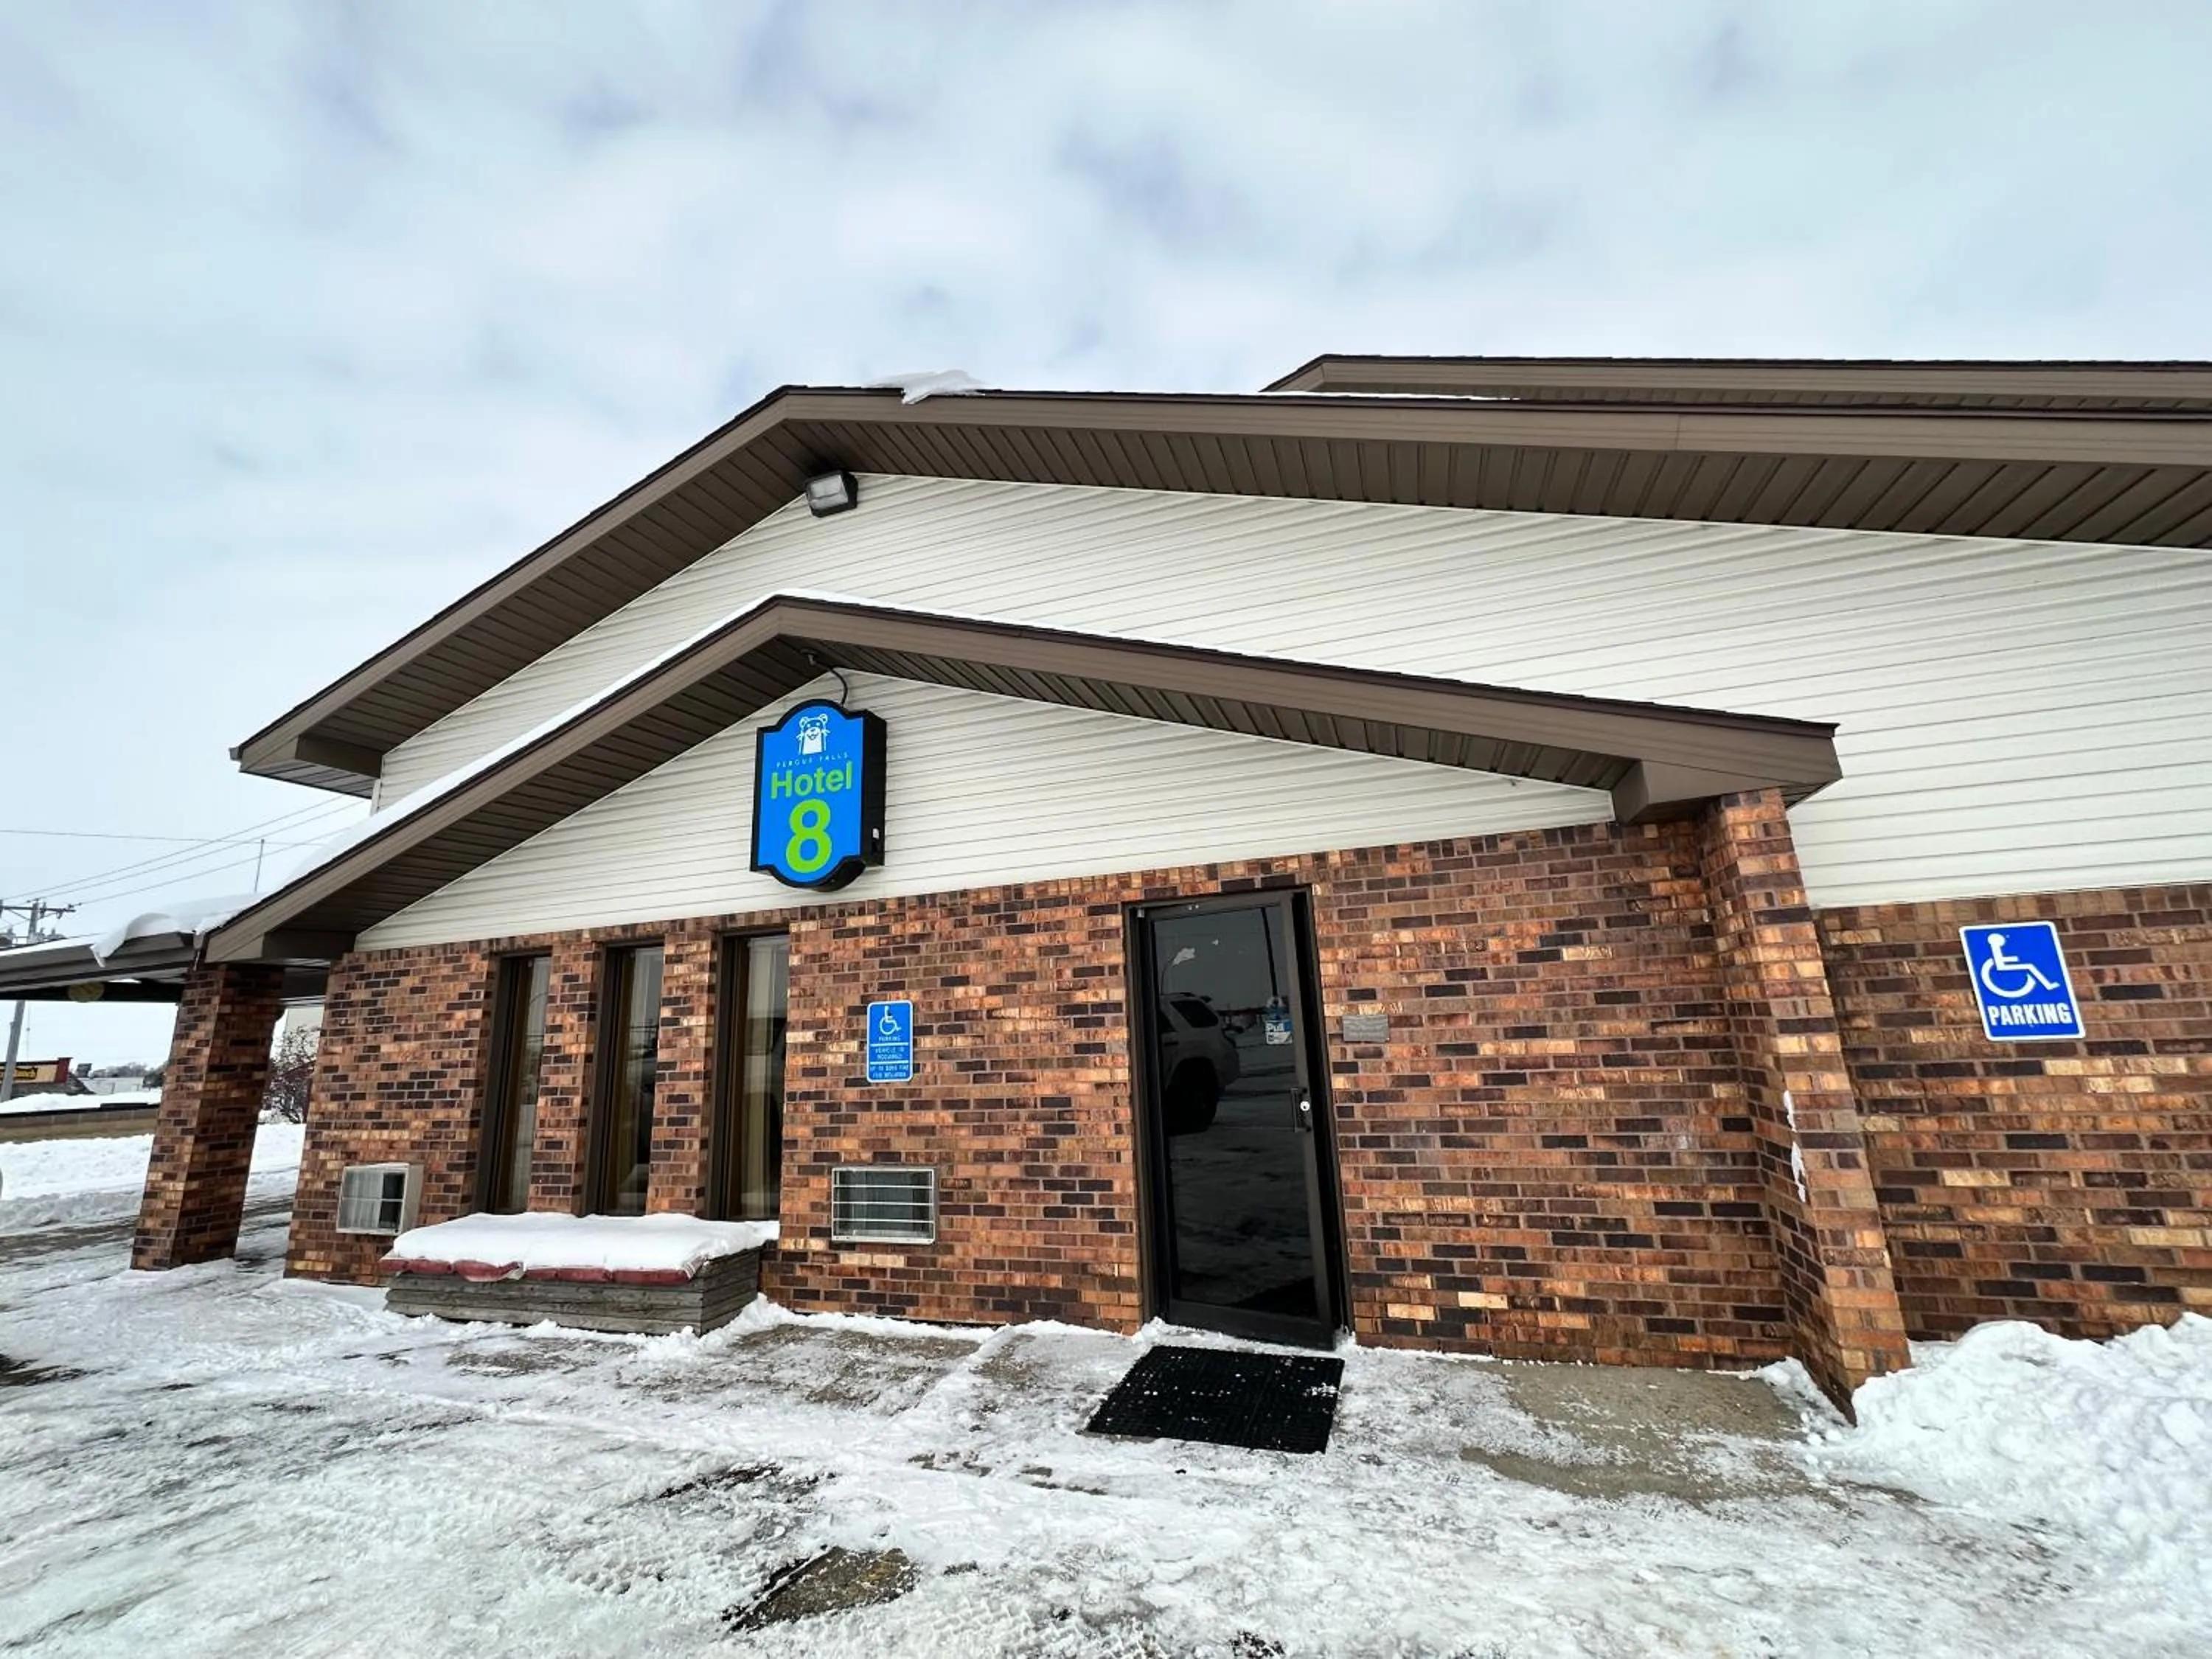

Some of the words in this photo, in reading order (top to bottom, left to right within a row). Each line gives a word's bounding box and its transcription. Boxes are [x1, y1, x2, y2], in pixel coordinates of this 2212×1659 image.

[771, 760, 852, 799] Hotel
[785, 799, 832, 874] 8
[1987, 1002, 2073, 1026] PARKING
